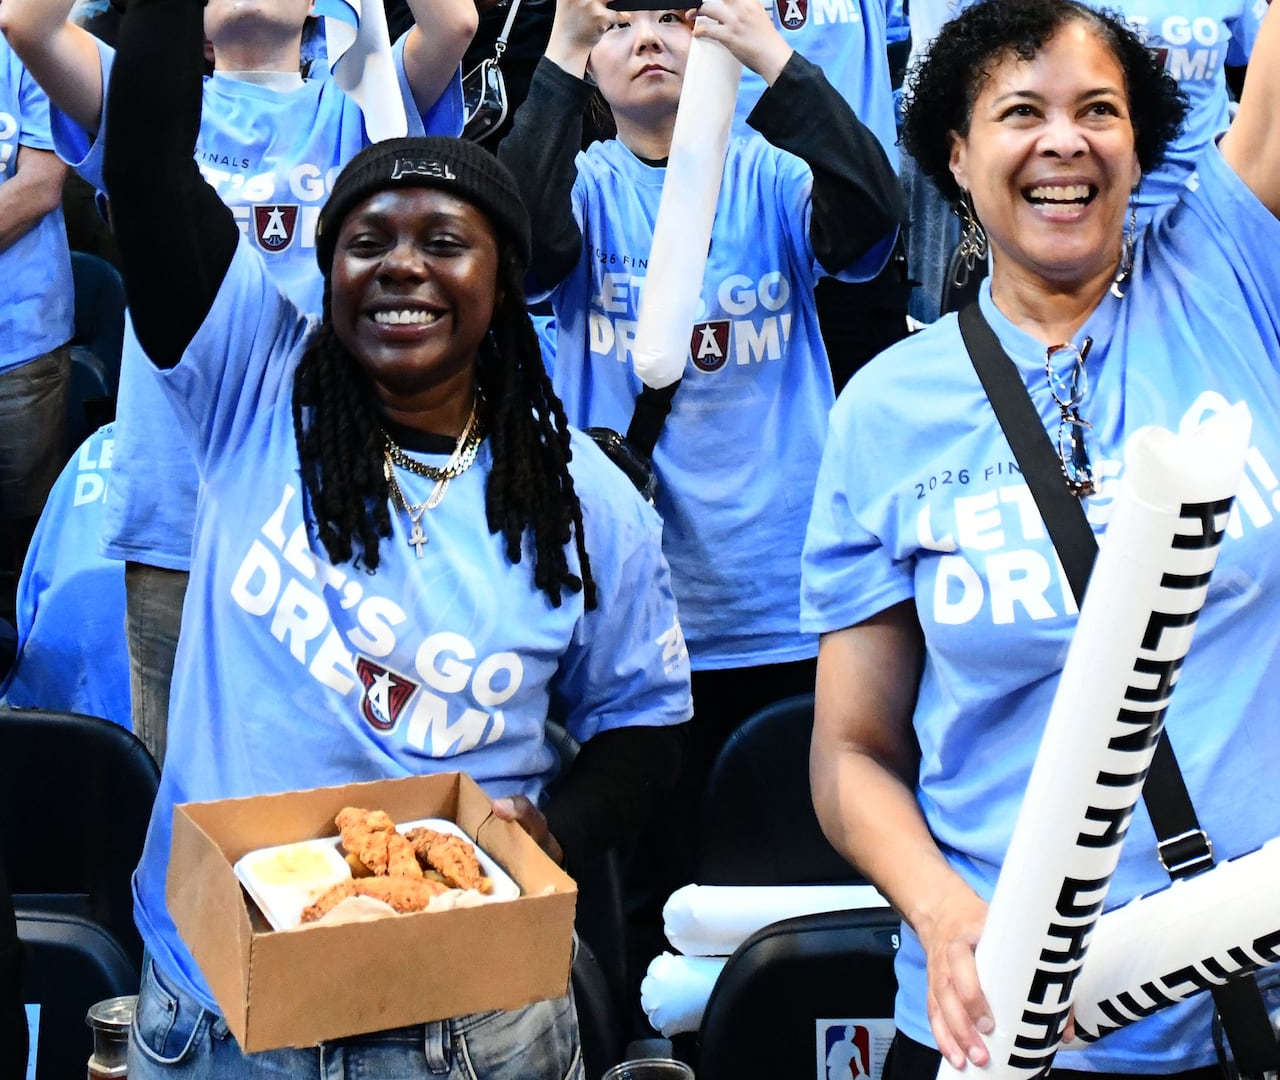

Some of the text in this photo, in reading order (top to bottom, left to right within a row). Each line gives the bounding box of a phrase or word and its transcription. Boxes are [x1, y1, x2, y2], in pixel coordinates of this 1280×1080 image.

[1162, 16, 1218, 46] GO
[198, 165, 276, 202] T'S
[623, 255, 649, 270] FIN
[717, 271, 791, 316] GO
[589, 313, 792, 374] DRAM!
[914, 459, 1022, 500] 2026 FIN
[414, 631, 525, 708] GO
[1075, 494, 1236, 848] ATLANTA
[891, 933, 900, 951] 9
